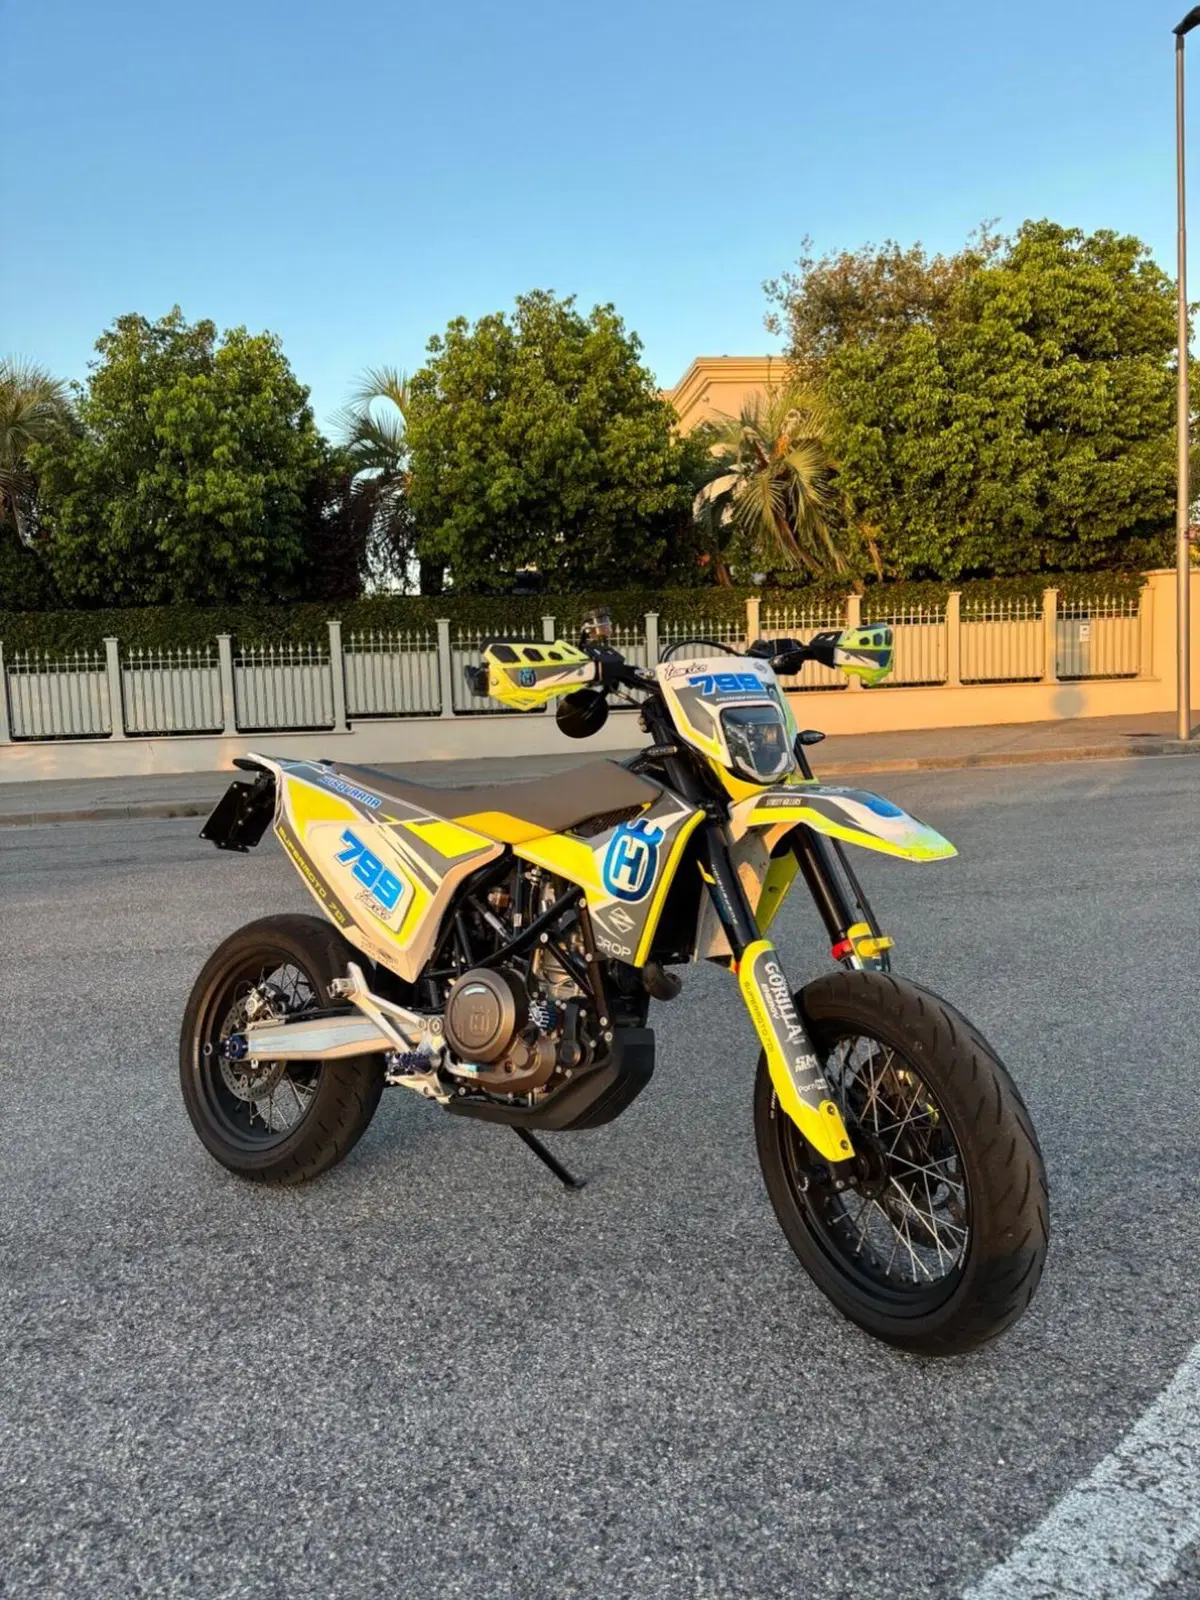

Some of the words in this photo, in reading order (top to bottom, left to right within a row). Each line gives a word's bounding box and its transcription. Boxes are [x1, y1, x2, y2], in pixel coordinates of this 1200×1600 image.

[687, 672, 767, 696] 799
[278, 826, 327, 898] SUPERMOTO
[333, 826, 405, 913] 799
